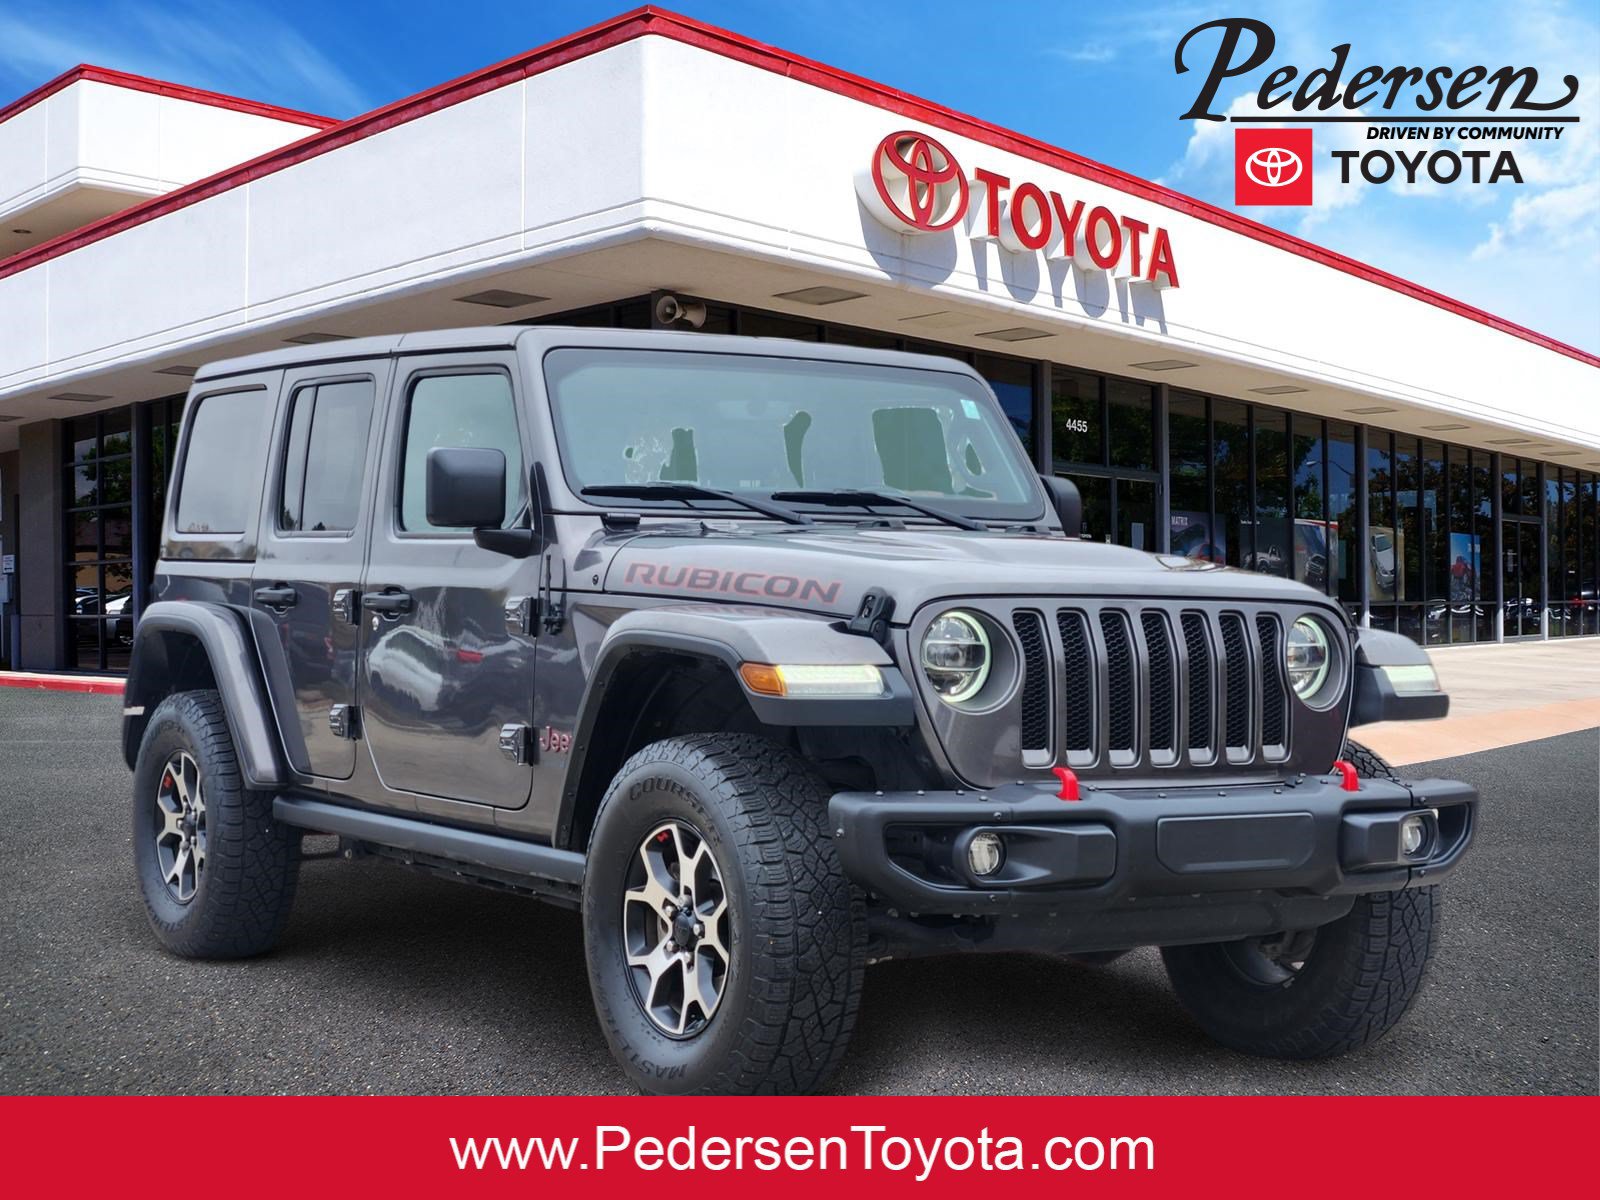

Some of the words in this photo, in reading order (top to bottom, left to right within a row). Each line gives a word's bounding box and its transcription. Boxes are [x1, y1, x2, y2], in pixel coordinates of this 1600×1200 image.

[975, 167, 1180, 288] TOYOTA
[1065, 418, 1088, 433] 4455
[624, 562, 843, 604] RUBICON
[539, 725, 573, 753] Jee
